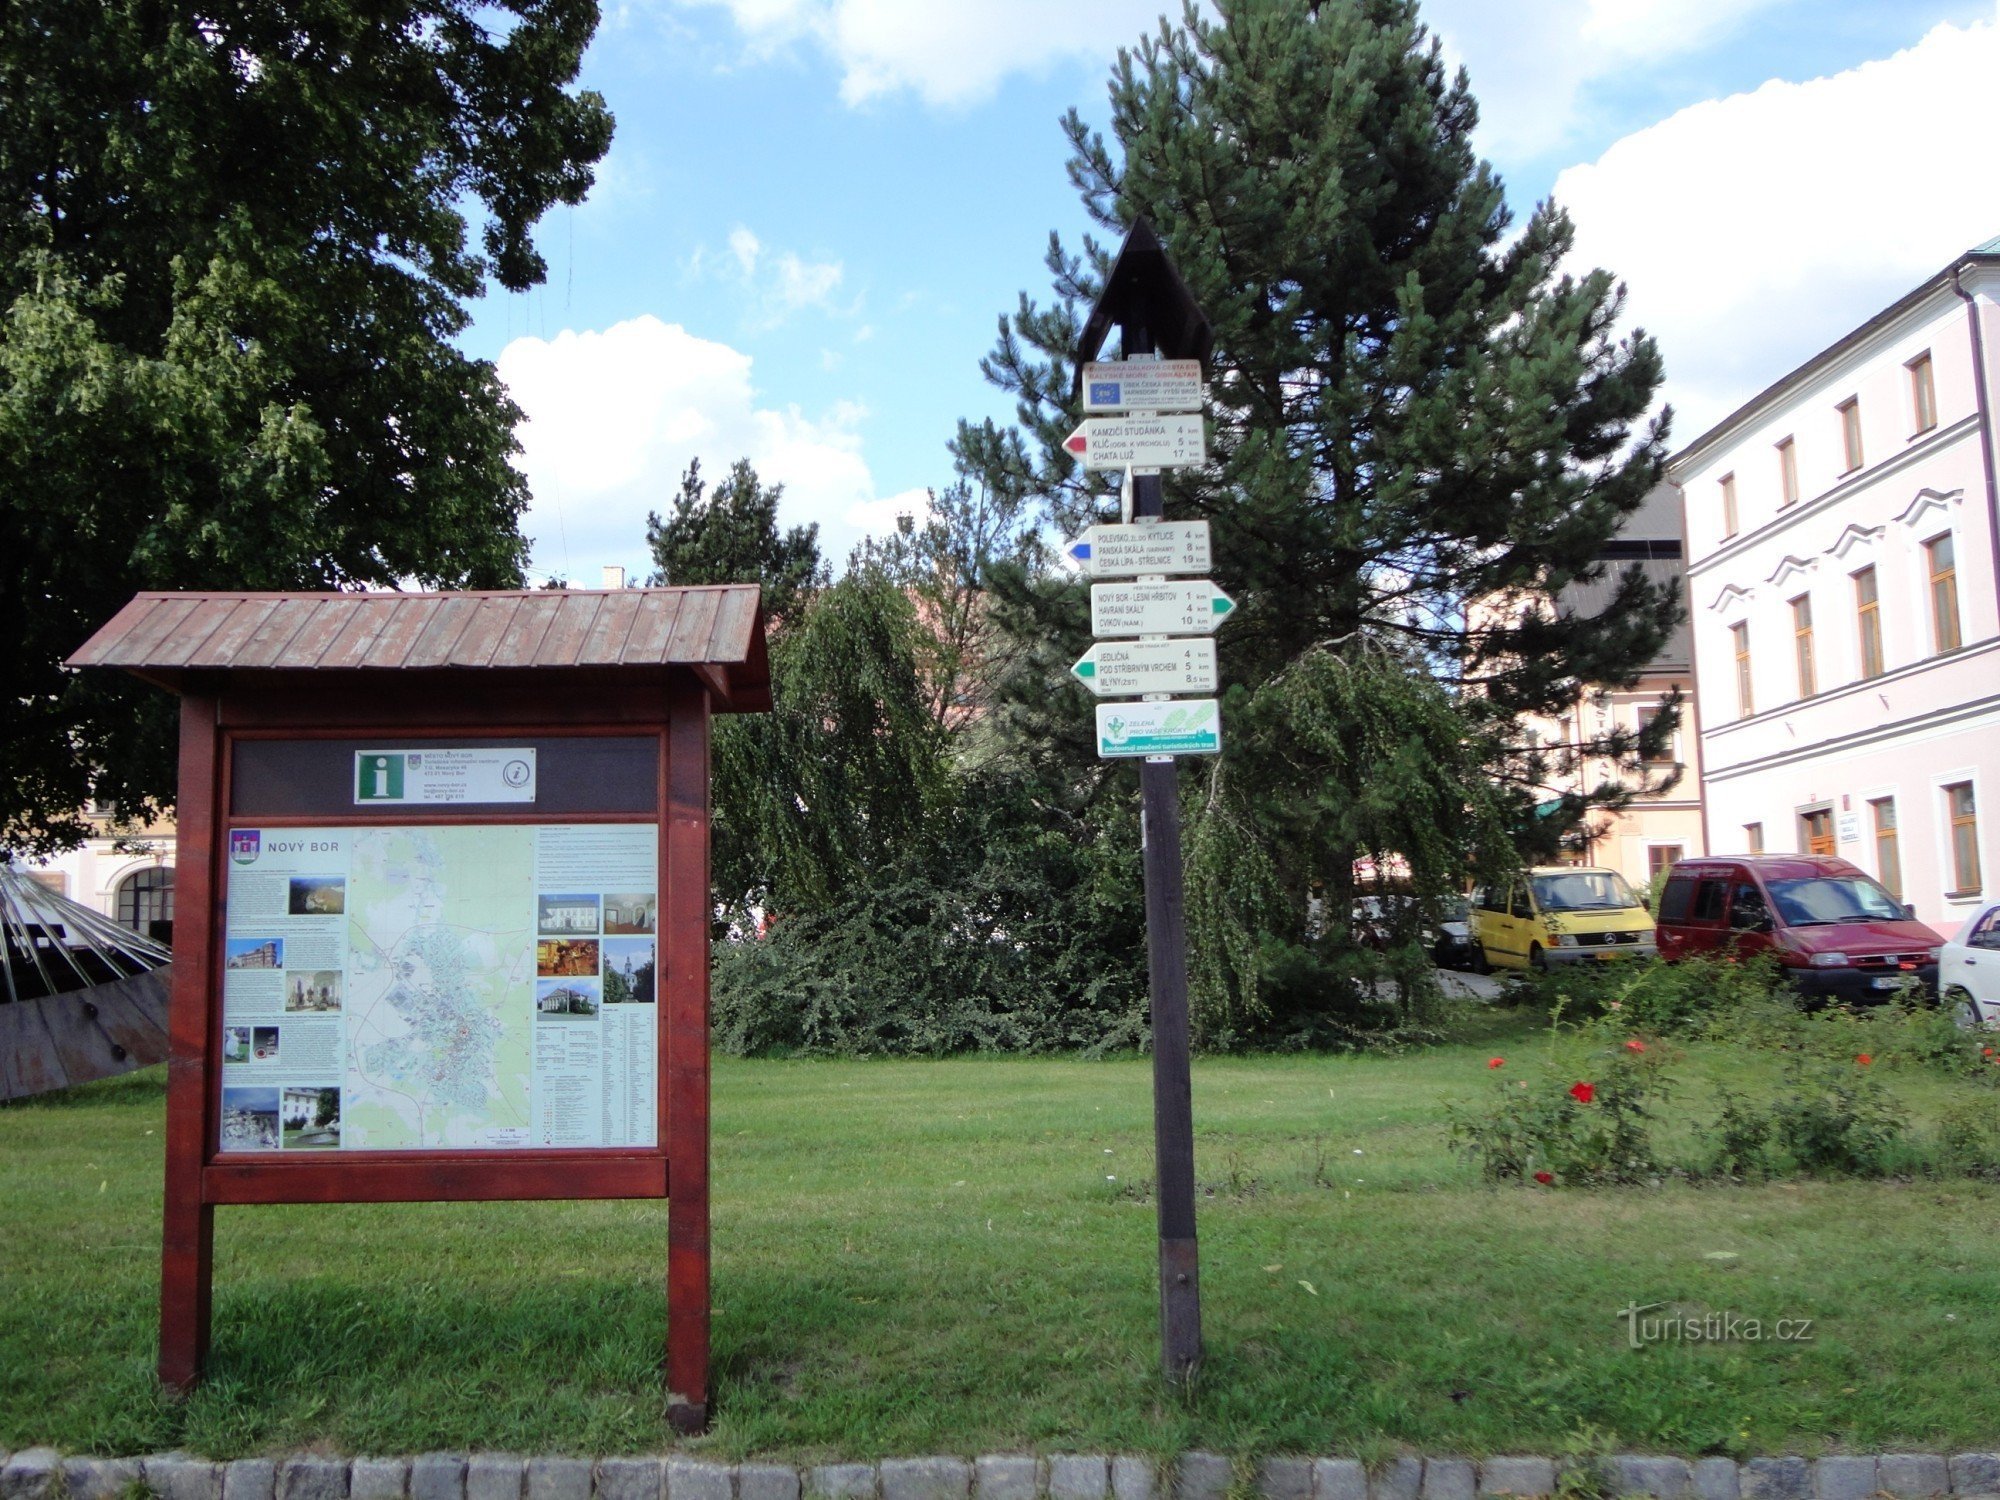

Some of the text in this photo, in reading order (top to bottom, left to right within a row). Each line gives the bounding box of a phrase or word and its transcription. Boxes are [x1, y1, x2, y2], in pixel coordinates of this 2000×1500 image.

[1092, 426, 1122, 437] KAMZIČÍ
[1124, 425, 1166, 436] STUDÁNKA
[1177, 426, 1183, 434] 4
[1178, 438, 1184, 446] 5
[1093, 451, 1118, 461] CHATA
[1120, 449, 1135, 460] LUŽ
[1173, 450, 1184, 458] 17
[1148, 531, 1174, 541] KYTLICE
[1185, 531, 1191, 539] 4
[1098, 546, 1123, 555] PANSKÁ
[1125, 545, 1144, 554] SKÁLA
[1187, 543, 1192, 551] 8
[1099, 557, 1119, 567] ČESKÁ
[1121, 556, 1134, 566] LÍPA
[1138, 555, 1172, 566] STŘELNICE
[1183, 555, 1193, 563] 19
[1098, 592, 1115, 603] NOVÝ
[1116, 593, 1128, 602] BOR
[1133, 592, 1150, 602] LESNÍ
[1151, 591, 1177, 602] HŘBITOV
[1186, 592, 1191, 600] 1
[1098, 605, 1124, 615] HAVRANÍ
[1125, 604, 1144, 614] SKÁLY
[1186, 604, 1192, 612] 4
[1181, 616, 1193, 625] 10
[1100, 651, 1130, 662] JEDLIČNÁ
[1184, 650, 1190, 658] 4
[1100, 665, 1112, 675] POD
[1114, 663, 1149, 674] STŘÍBRNÝM
[1151, 662, 1177, 672] VRCHEM
[1185, 662, 1191, 670] 5
[268, 840, 339, 852] NOVÝ BOR
